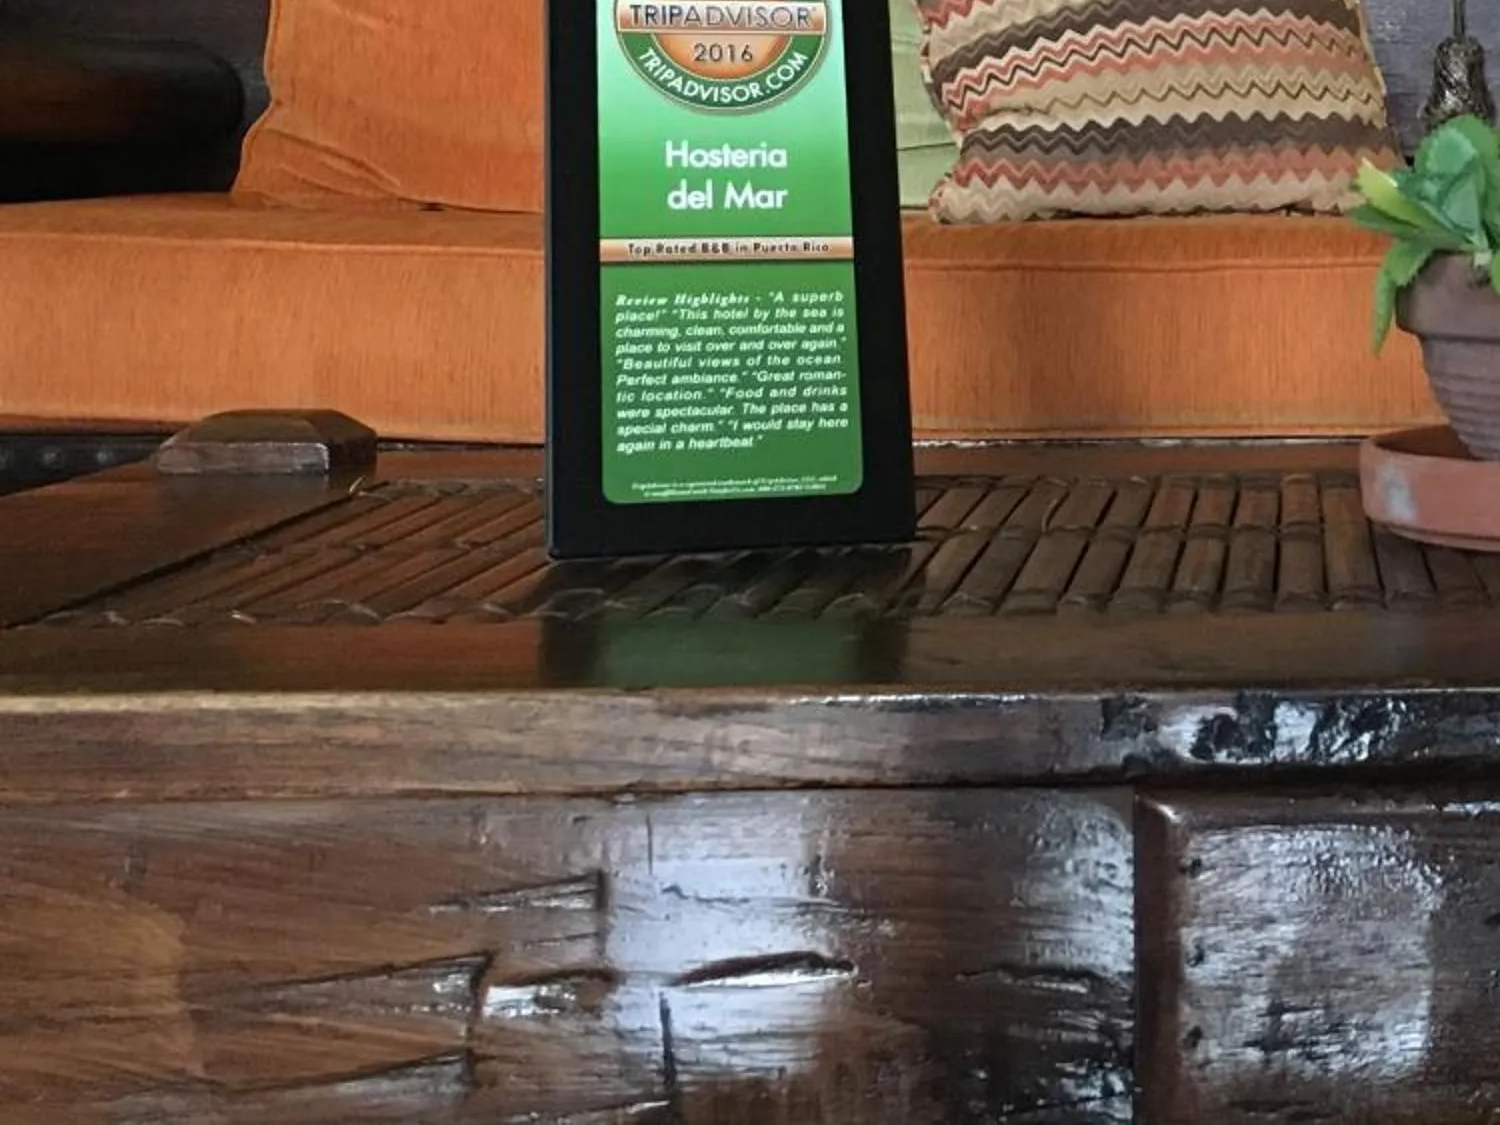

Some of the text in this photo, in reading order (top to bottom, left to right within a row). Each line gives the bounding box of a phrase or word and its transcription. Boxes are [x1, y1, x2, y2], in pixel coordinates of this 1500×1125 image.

[629, 5, 810, 28] TRIPADVISOR
[694, 44, 753, 63] 2016
[639, 49, 808, 103] TRIPADVISOR.COM
[665, 140, 788, 168] Hosteria
[668, 179, 788, 209] del Mar
[628, 241, 829, 256] Top Rated B&B in Puerto Rico
[616, 295, 667, 306] Review
[792, 291, 843, 303] superb
[713, 308, 748, 320] hotel
[754, 309, 770, 321] by
[775, 308, 797, 318] the
[803, 308, 827, 318] sea
[832, 308, 844, 317] is
[730, 323, 806, 334] comfortable
[809, 323, 833, 333] and
[837, 324, 844, 332] a
[616, 343, 652, 356] place
[658, 342, 670, 353] to
[676, 341, 701, 352] visit
[706, 342, 735, 352] over
[739, 340, 764, 351] and
[768, 341, 797, 350] over
[699, 358, 740, 367] views
[746, 356, 761, 366] of
[768, 355, 790, 365] the
[616, 374, 667, 385] Perfect
[616, 391, 634, 402] tic
[770, 386, 796, 397] and
[803, 385, 847, 396] drinks
[617, 409, 649, 419] were
[742, 403, 766, 414] The
[771, 402, 807, 415] place
[812, 402, 834, 412] has
[840, 403, 848, 411] a
[617, 423, 666, 436] special
[743, 419, 781, 430] would
[786, 419, 814, 432] stay
[817, 418, 848, 428] here
[617, 441, 654, 455] again
[659, 439, 671, 450] in
[676, 441, 684, 449] a
